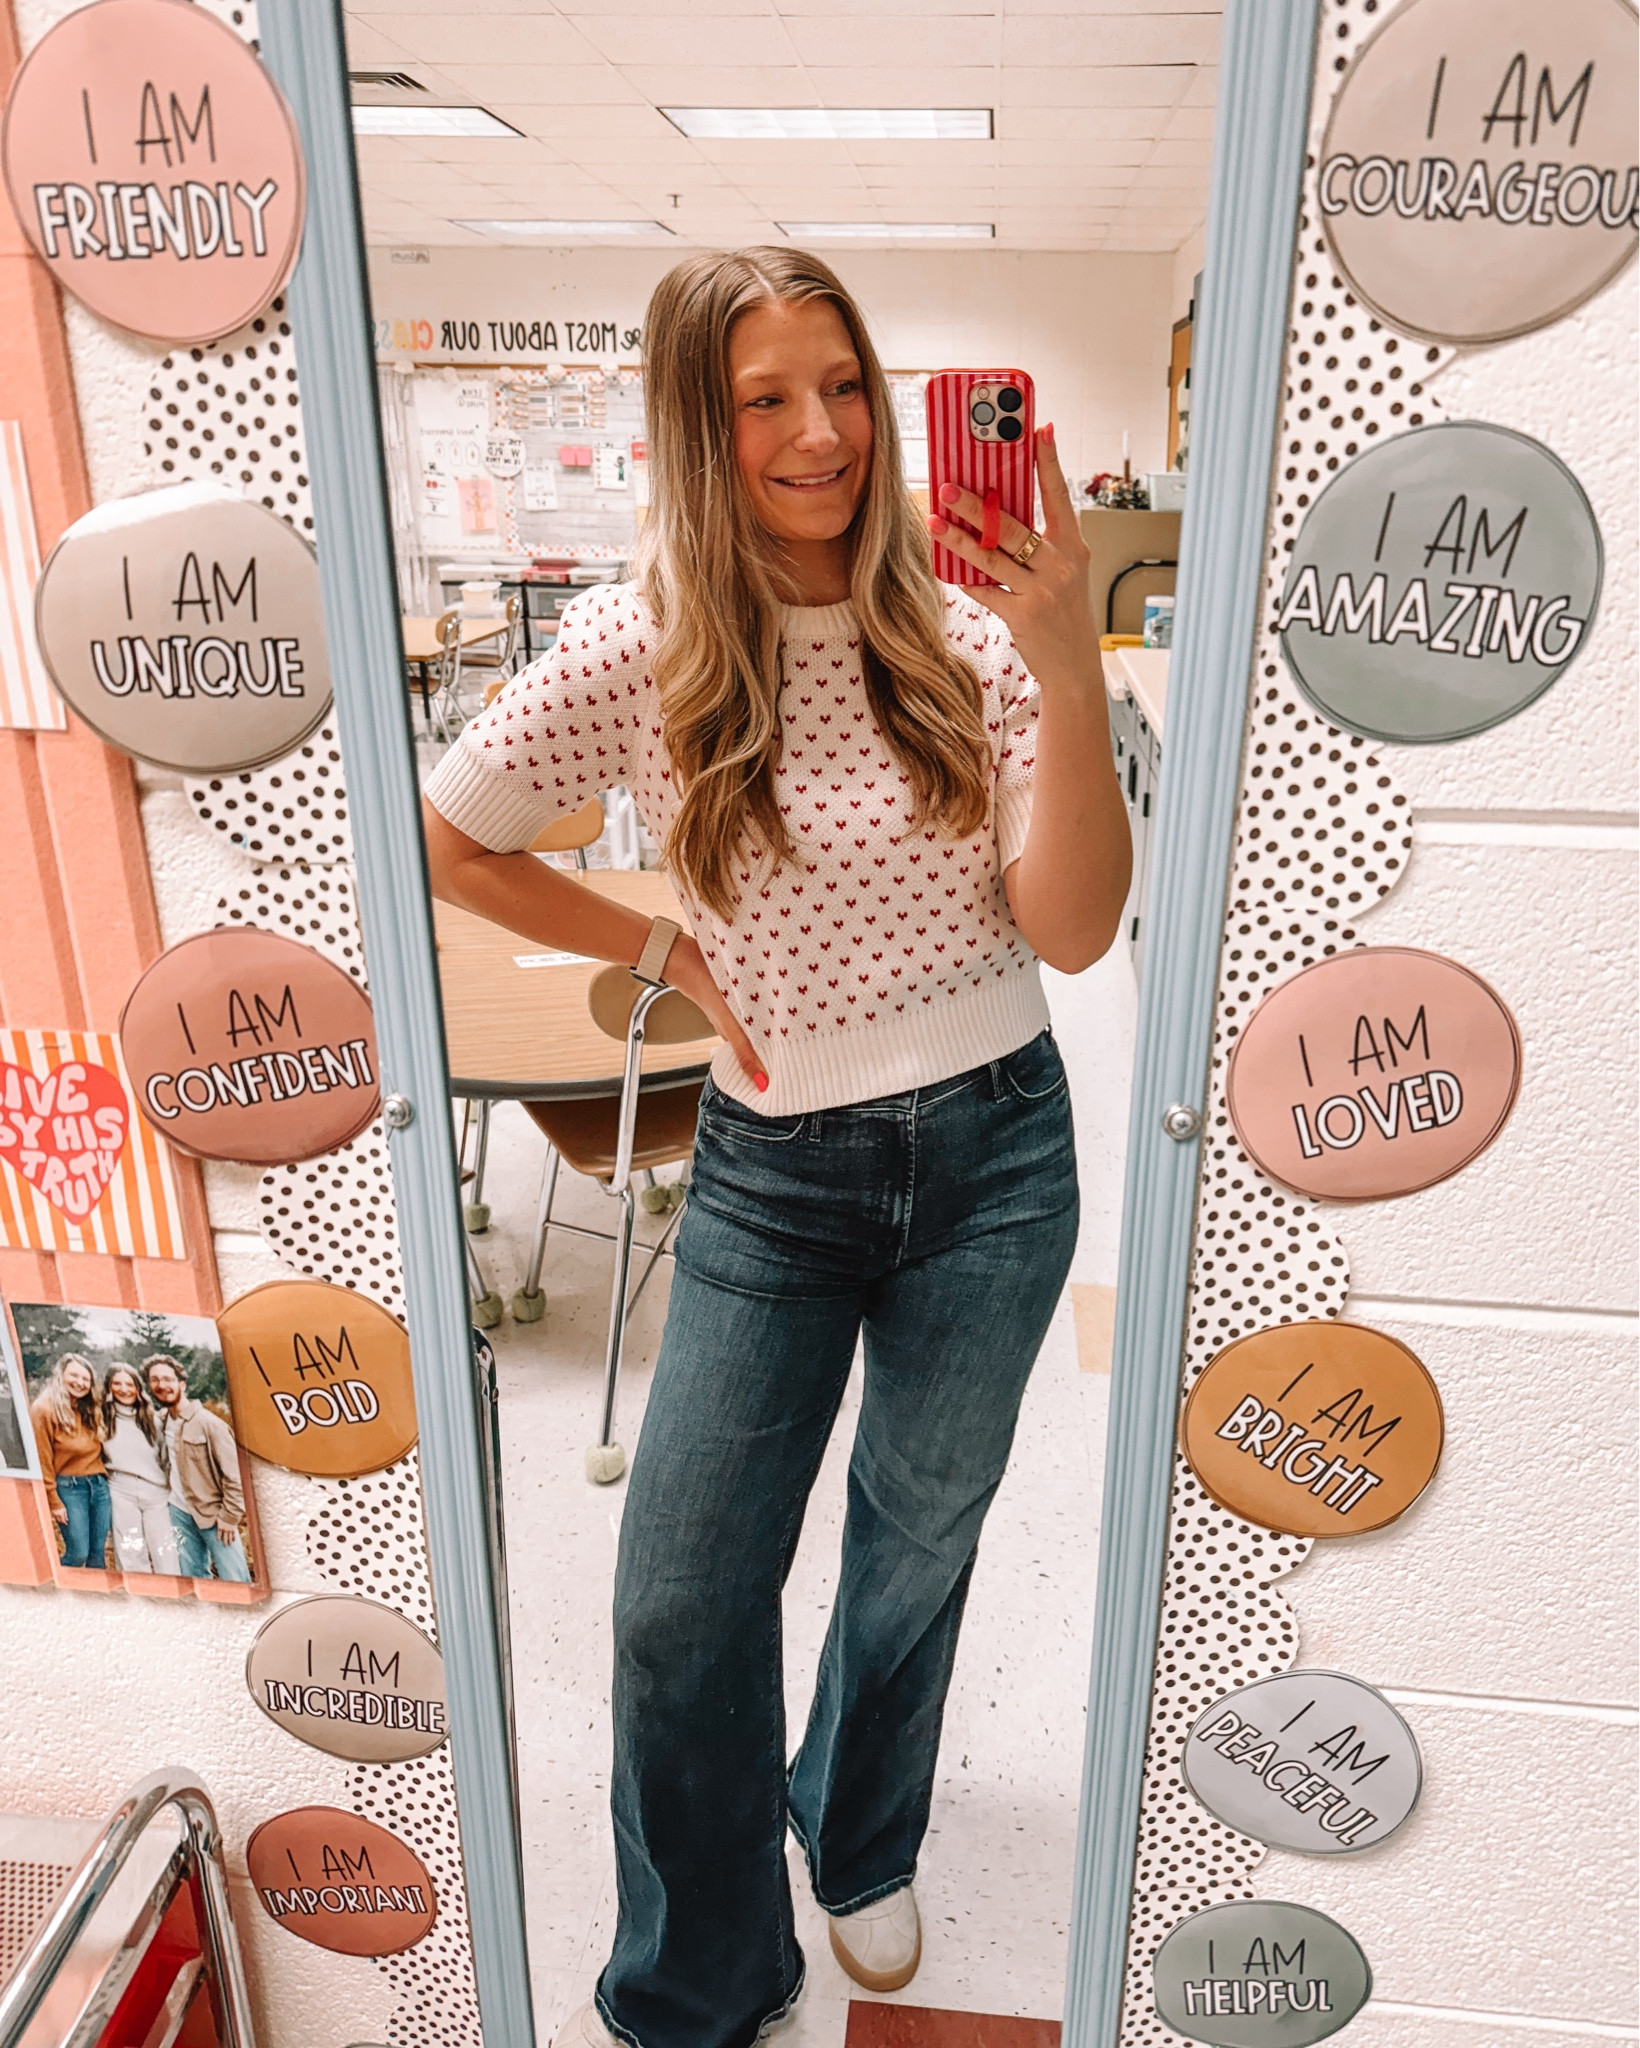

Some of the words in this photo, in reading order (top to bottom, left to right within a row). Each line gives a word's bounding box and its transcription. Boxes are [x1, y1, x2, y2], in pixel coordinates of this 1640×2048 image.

[83, 88, 98, 165] I
[135, 80, 217, 167] AM
[1427, 55, 1447, 140] I
[1481, 51, 1595, 149] AM
[33, 178, 278, 260] FRIENDLY
[1319, 153, 1639, 230] COURAGEOU
[1374, 491, 1395, 562] I
[1424, 494, 1528, 578] AM
[123, 555, 133, 620] I
[172, 551, 258, 625] AM
[1277, 565, 1585, 666] AMAZING
[91, 635, 305, 699] UNIQUE
[177, 1002, 196, 1055] I
[226, 984, 302, 1048] AM
[1298, 1034, 1313, 1087] I
[1348, 1004, 1430, 1076] AM
[0, 1063, 90, 1117] IVE
[145, 1038, 375, 1120] CONFIDENT
[1292, 1070, 1463, 1159] LOVED
[52, 1106, 124, 1151] HIS
[19, 1149, 115, 1215] TRUTH
[250, 1345, 272, 1387] I
[294, 1326, 359, 1380] AM
[270, 1379, 380, 1436] BOLD
[1277, 1363, 1314, 1402] I
[1311, 1388, 1402, 1457] AM
[1215, 1393, 1383, 1515] BRIGHT
[307, 1639, 313, 1678] I
[340, 1642, 401, 1688] AM
[264, 1679, 445, 1735] INCREDIBLE
[1280, 1699, 1316, 1733] I
[1307, 1725, 1391, 1786] AM
[1196, 1710, 1378, 1846] PEACEFUL
[286, 1848, 301, 1881] I
[321, 1844, 376, 1882] AM
[262, 1885, 429, 1917] IMPORTANT
[1209, 1939, 1215, 1975] I
[1242, 1936, 1306, 1977] AM
[1184, 1979, 1333, 2017] HELPFUL
